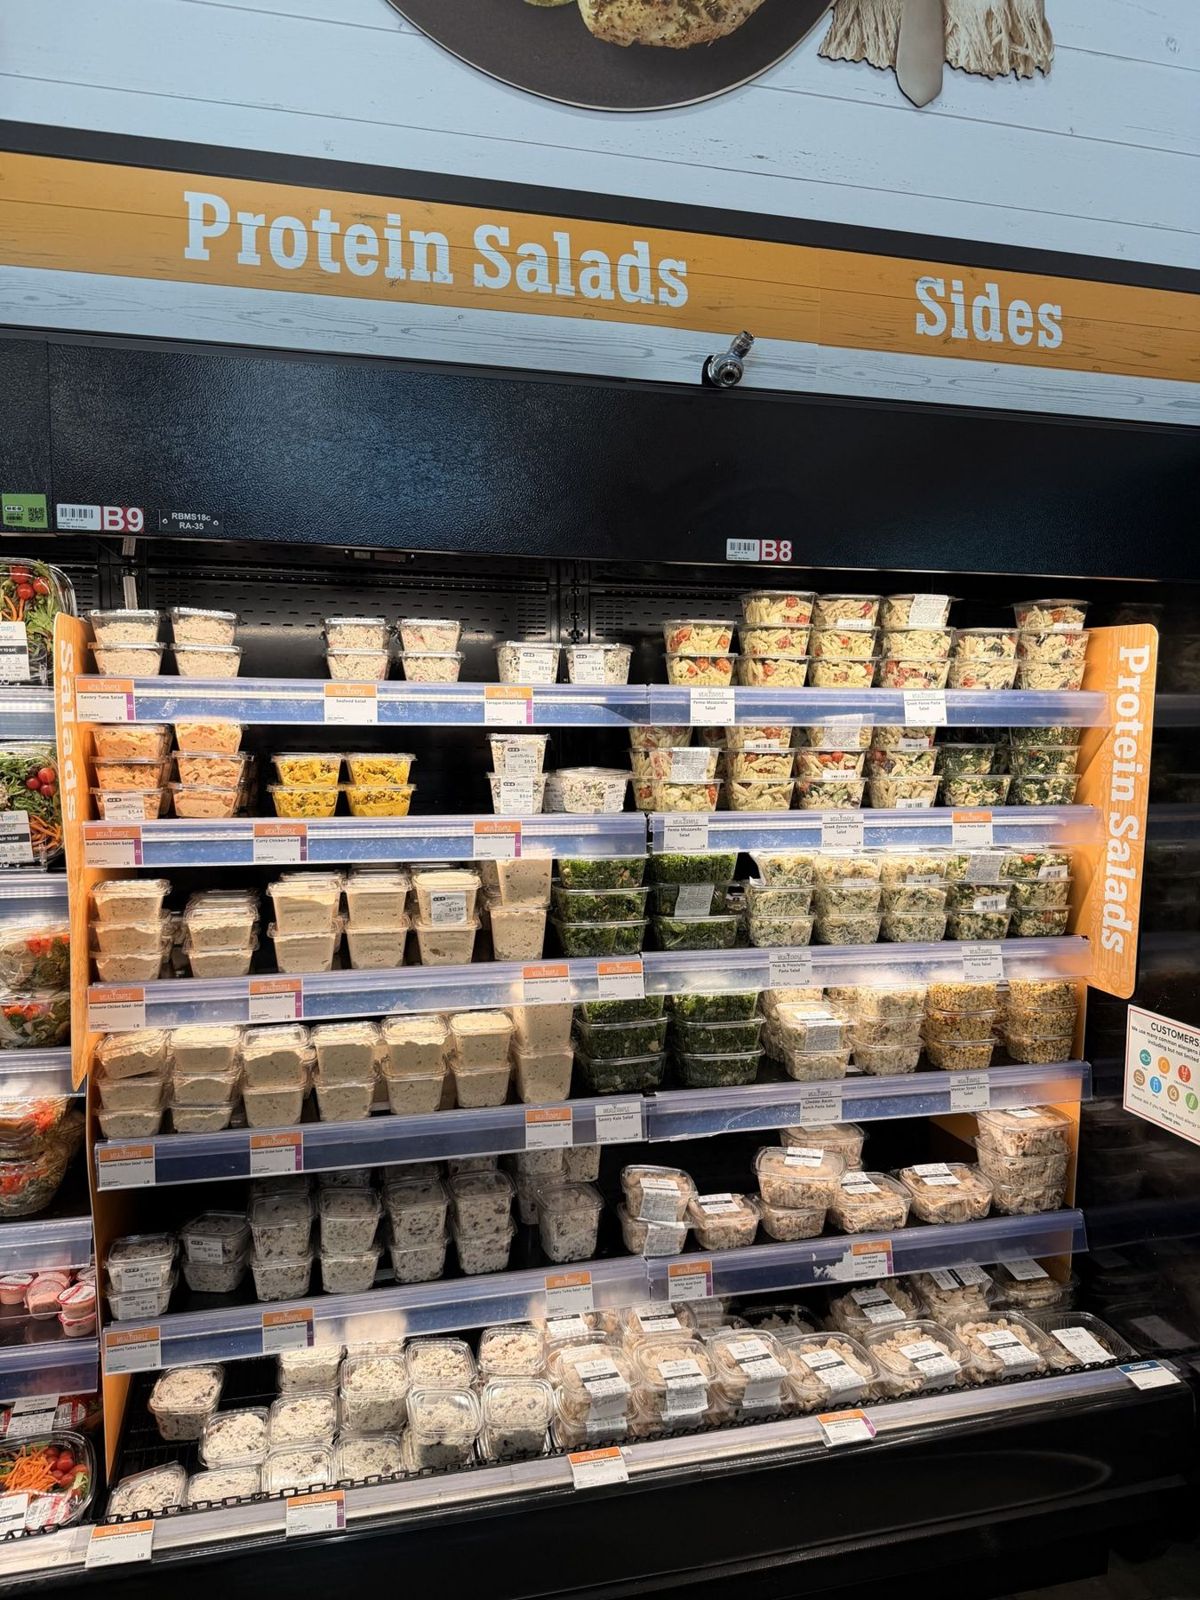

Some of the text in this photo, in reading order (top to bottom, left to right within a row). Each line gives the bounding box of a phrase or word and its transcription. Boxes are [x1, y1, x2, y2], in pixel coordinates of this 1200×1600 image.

[184, 190, 688, 308] Protein Salads
[916, 277, 1063, 348] Sides
[103, 506, 144, 533] B9
[171, 512, 211, 522] RBMS18c
[179, 521, 204, 530] RA-35
[761, 539, 792, 562] B8
[60, 639, 77, 822] Salads
[1102, 645, 1150, 954] Protein Salads
[1148, 1039, 1167, 1051] including
[1184, 1053, 1199, 1063] limited
[1158, 1035, 1177, 1047] common
[1178, 1043, 1198, 1056] allergens
